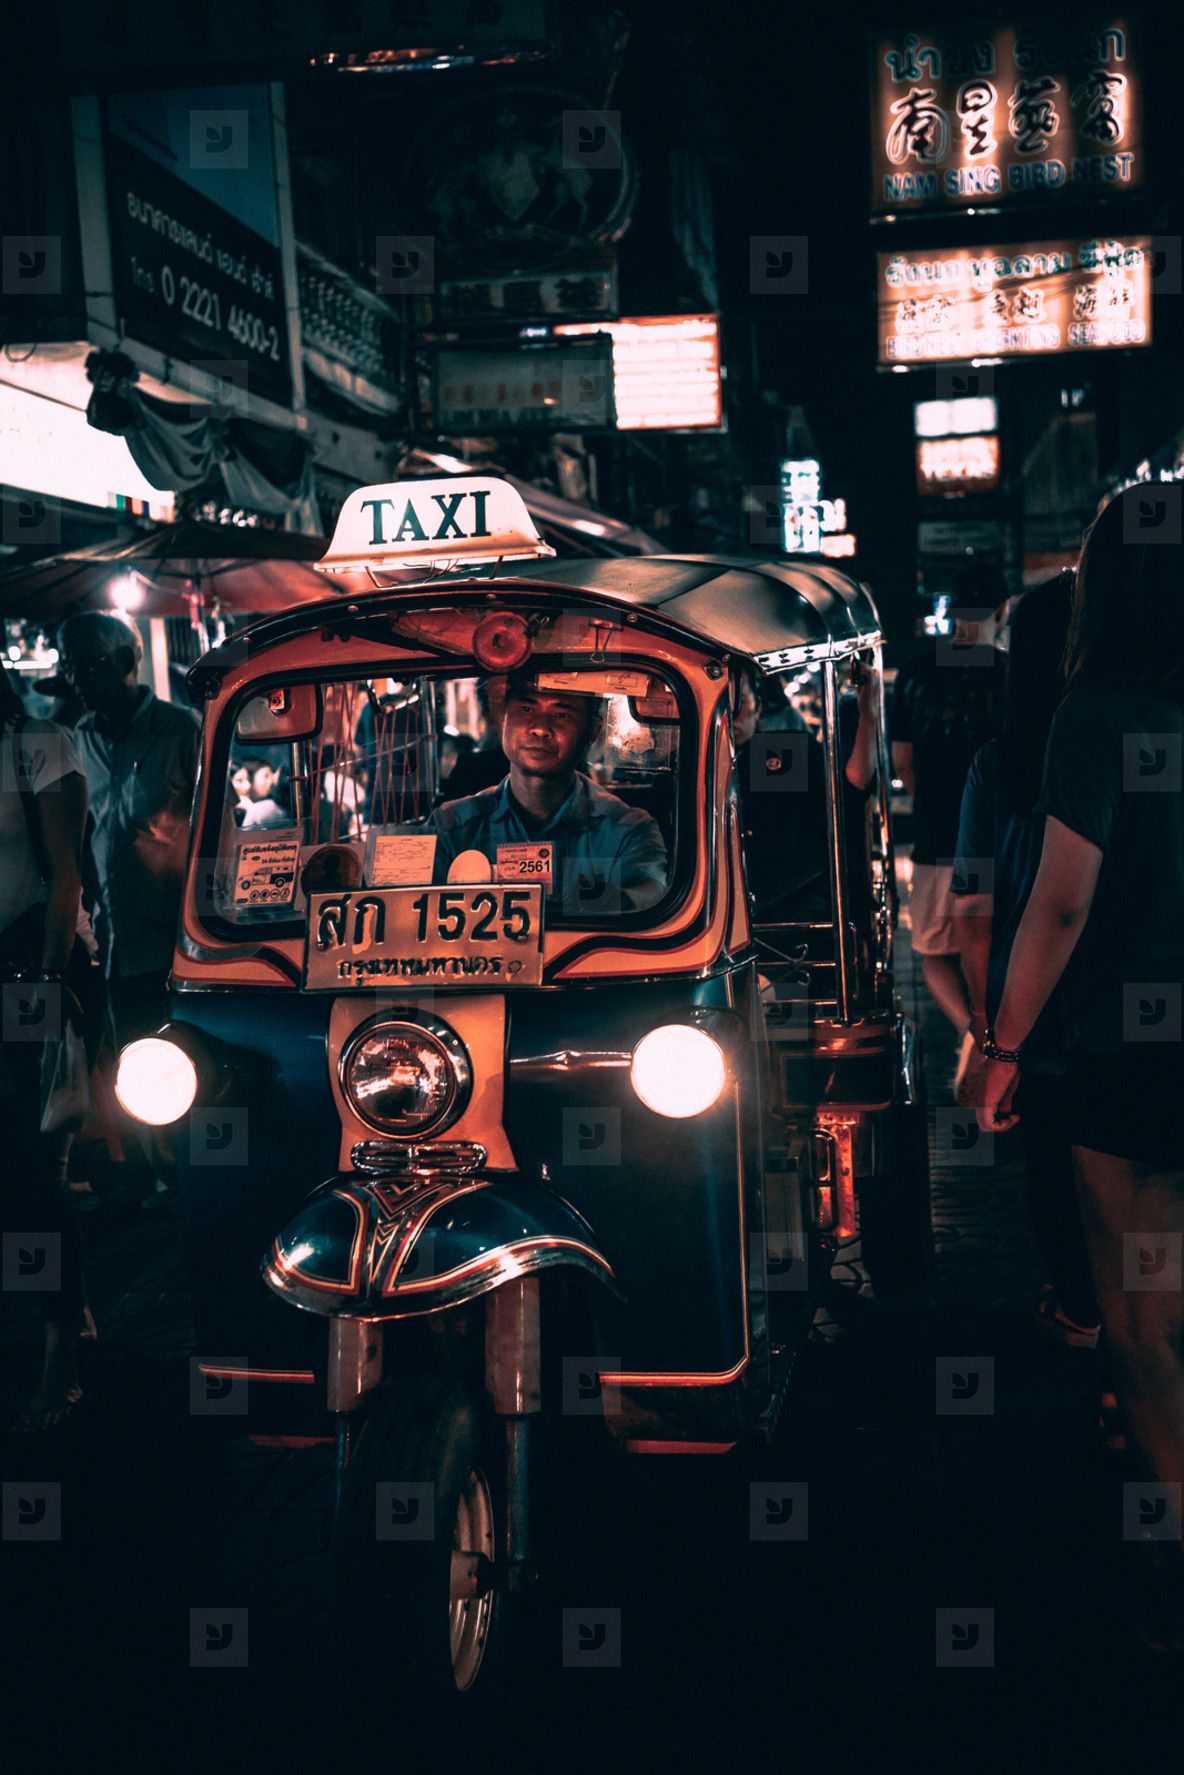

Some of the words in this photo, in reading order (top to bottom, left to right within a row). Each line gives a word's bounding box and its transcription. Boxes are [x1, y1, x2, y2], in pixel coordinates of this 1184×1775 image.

[884, 172, 937, 200] NAM
[943, 163, 1001, 196] SING
[1008, 159, 1066, 190] BIRD
[1071, 151, 1134, 185] NEST
[161, 264, 175, 306] 0
[179, 275, 222, 331] 2221
[227, 304, 280, 362] 4600-2
[360, 491, 491, 545] TAXI
[519, 860, 550, 873] 2561
[317, 894, 386, 951] สก
[412, 891, 531, 943] 1525
[338, 955, 504, 987] กรุงเทพมหานคร
